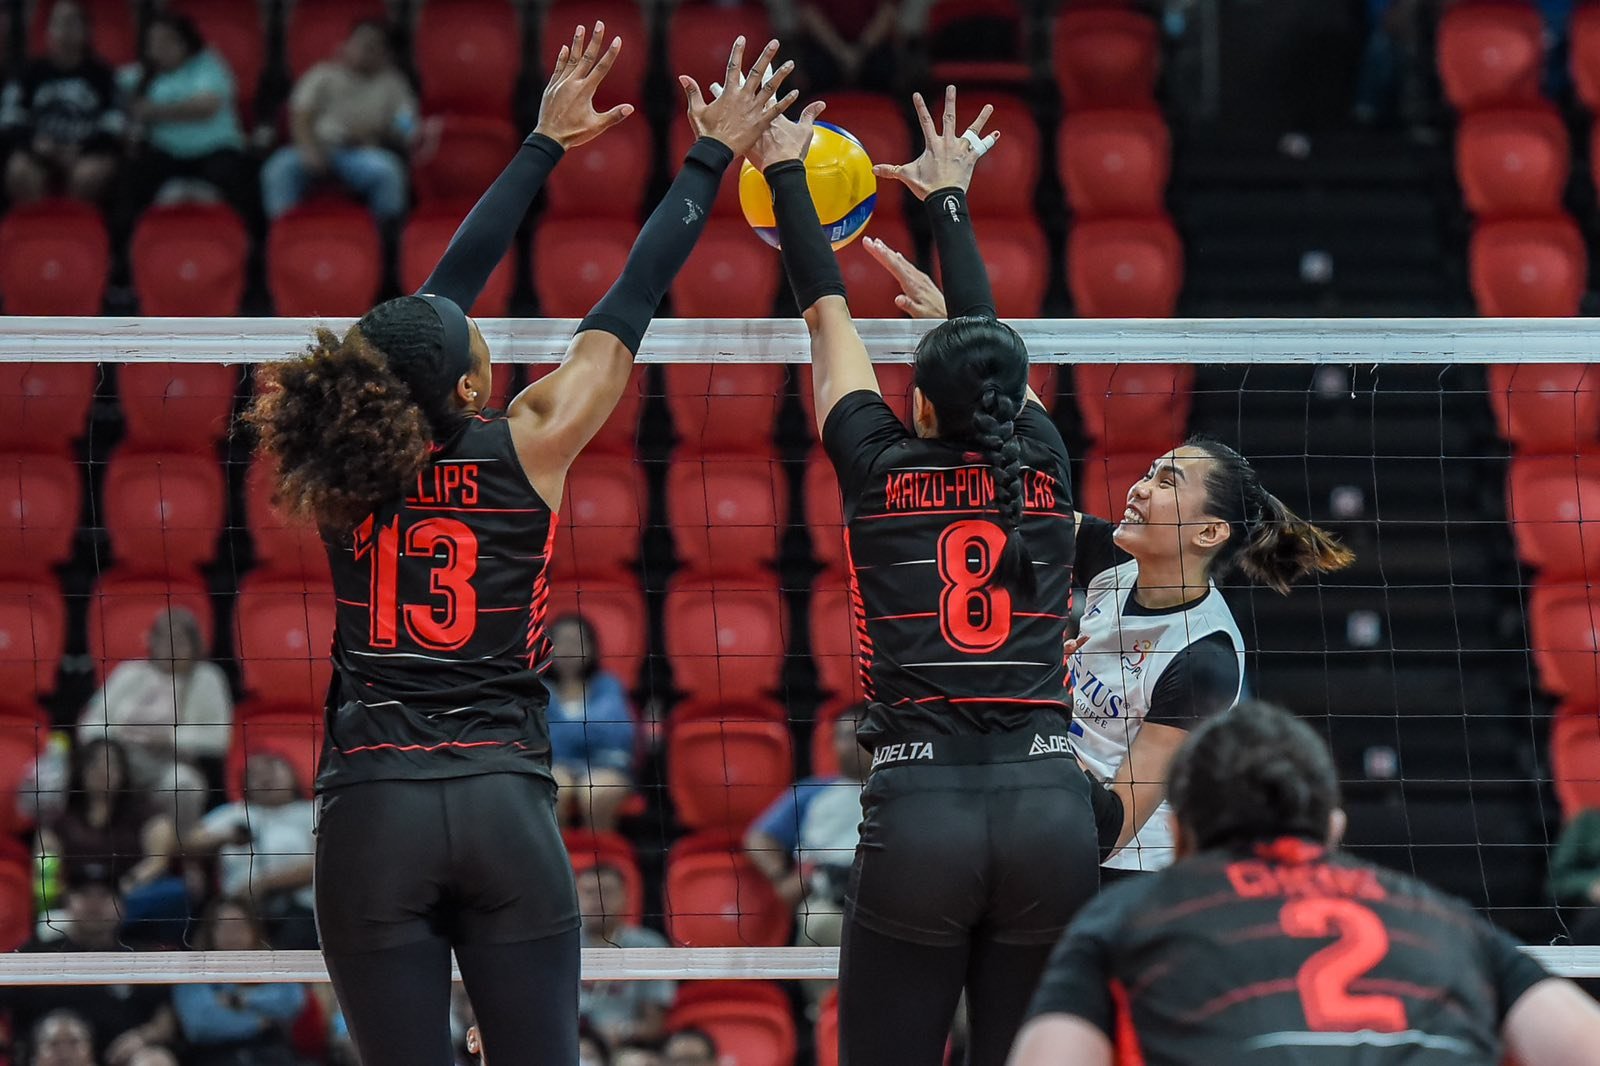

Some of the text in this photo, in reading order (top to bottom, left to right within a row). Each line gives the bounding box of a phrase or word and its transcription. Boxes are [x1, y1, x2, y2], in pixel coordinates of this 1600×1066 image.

[353, 512, 478, 652] 13
[936, 519, 1011, 654] 8
[1075, 698, 1108, 729] COFFEE
[1080, 670, 1123, 719] ZUS
[1049, 735, 1073, 753] DEL
[1280, 897, 1407, 1032] 2
